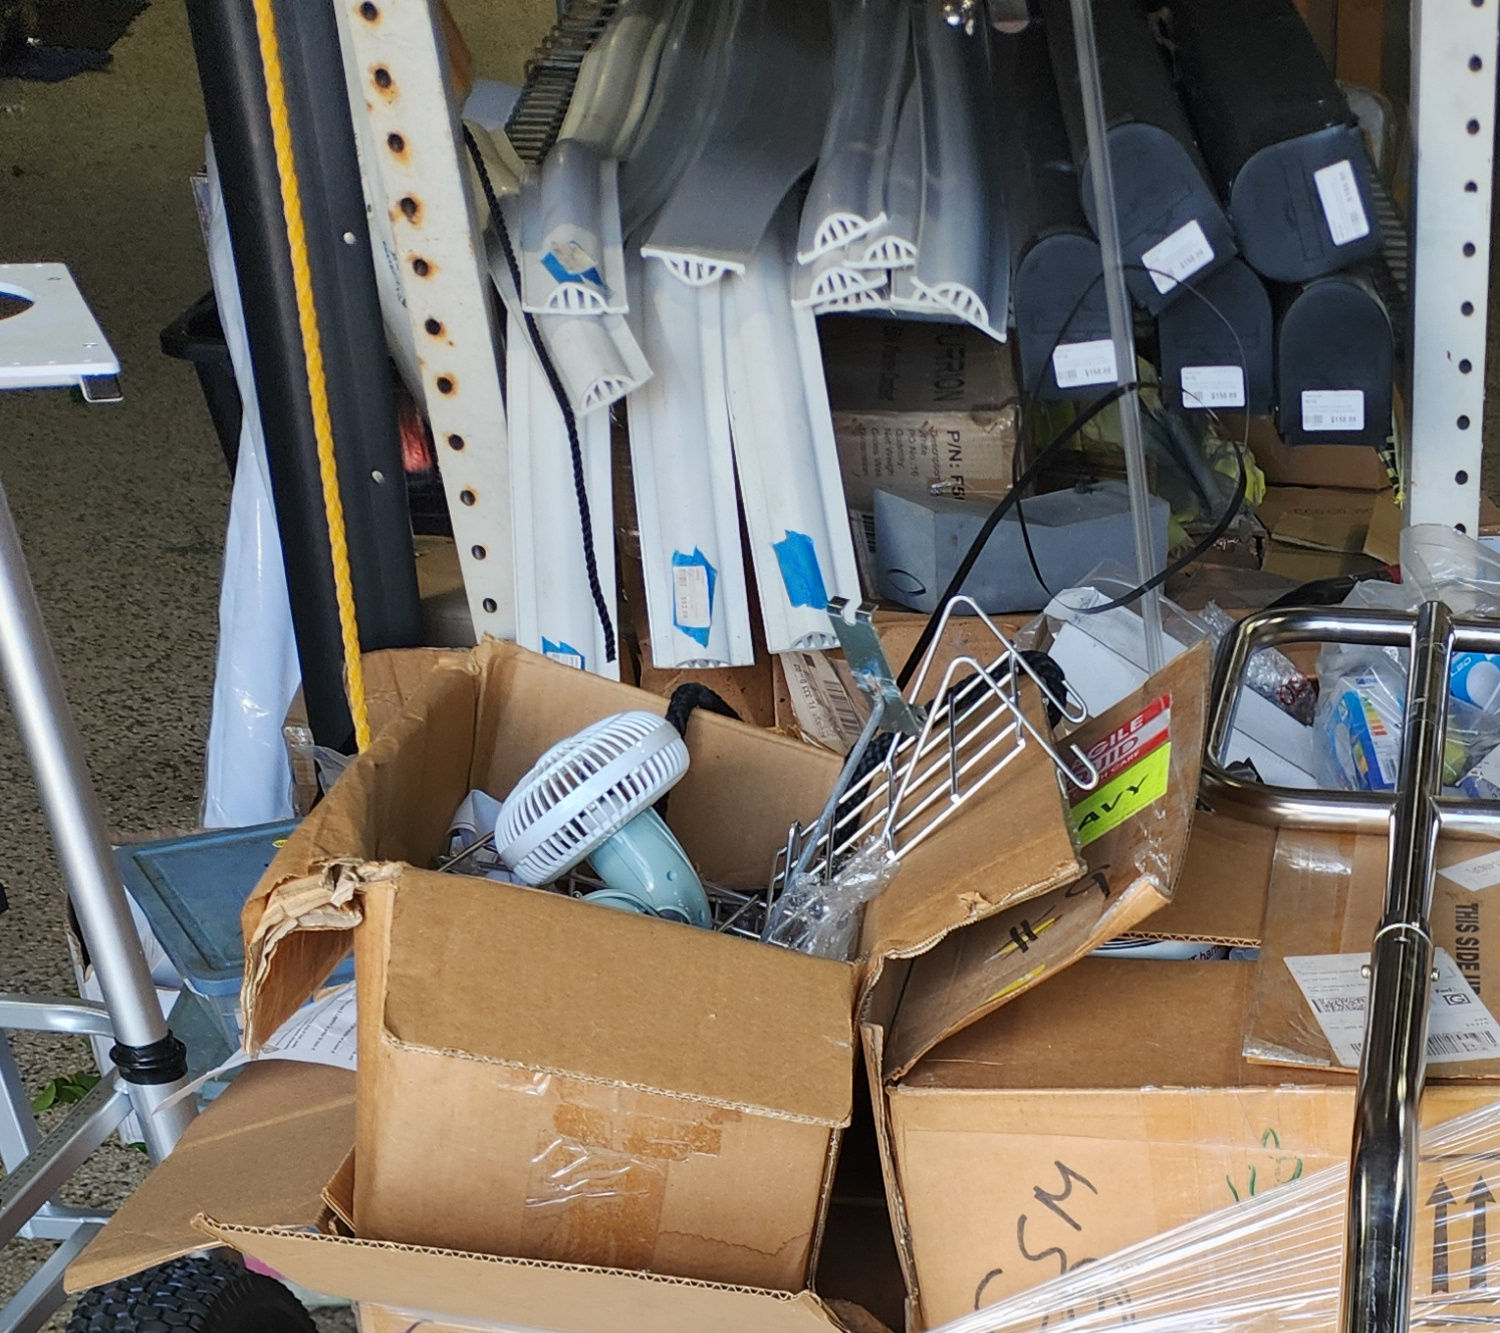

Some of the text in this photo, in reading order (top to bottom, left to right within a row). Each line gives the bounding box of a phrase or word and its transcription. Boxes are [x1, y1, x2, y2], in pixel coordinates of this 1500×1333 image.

[946, 429, 963, 468] P/N:
[1078, 773, 1150, 832] AVY
[1455, 902, 1479, 933] THIS
[1455, 936, 1480, 972] SIDE
